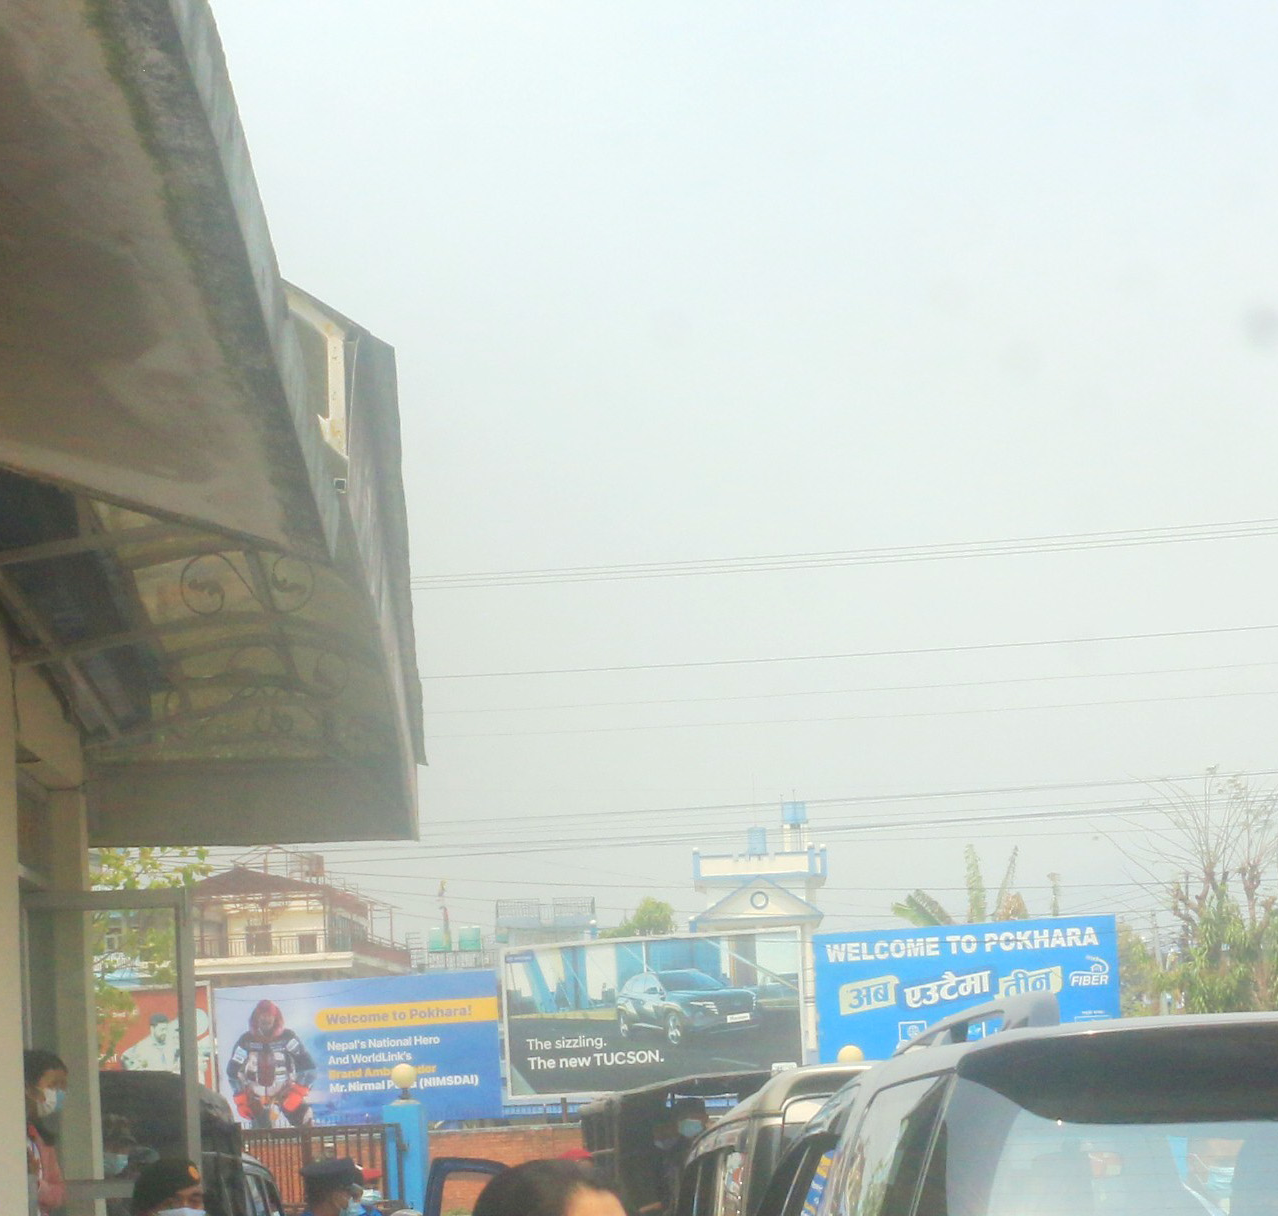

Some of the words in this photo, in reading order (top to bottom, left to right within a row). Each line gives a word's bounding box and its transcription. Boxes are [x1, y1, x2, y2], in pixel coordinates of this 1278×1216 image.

[825, 936, 940, 963] WELCOME
[945, 934, 977, 955] TO
[984, 926, 1100, 953] POKHARA
[1070, 974, 1109, 987] FIBER
[326, 1011, 389, 1026] Welcome
[393, 1008, 407, 1021] to
[409, 1004, 473, 1021] Pokhara!
[327, 1038, 366, 1053] Nepal's
[368, 1036, 412, 1050] National
[414, 1034, 441, 1046] Hero
[526, 1038, 553, 1051] The
[555, 1035, 608, 1050] sizzling.
[328, 1053, 350, 1066] And
[352, 1051, 412, 1065] WorldLink's
[527, 1057, 557, 1070] The
[559, 1055, 592, 1069] new
[593, 1050, 665, 1066] TUCSON.
[328, 1067, 363, 1080] Brand
[330, 1082, 348, 1094] Mr.
[348, 1079, 386, 1092] Nirmal
[419, 1074, 480, 1090] (NIMSDAI)
